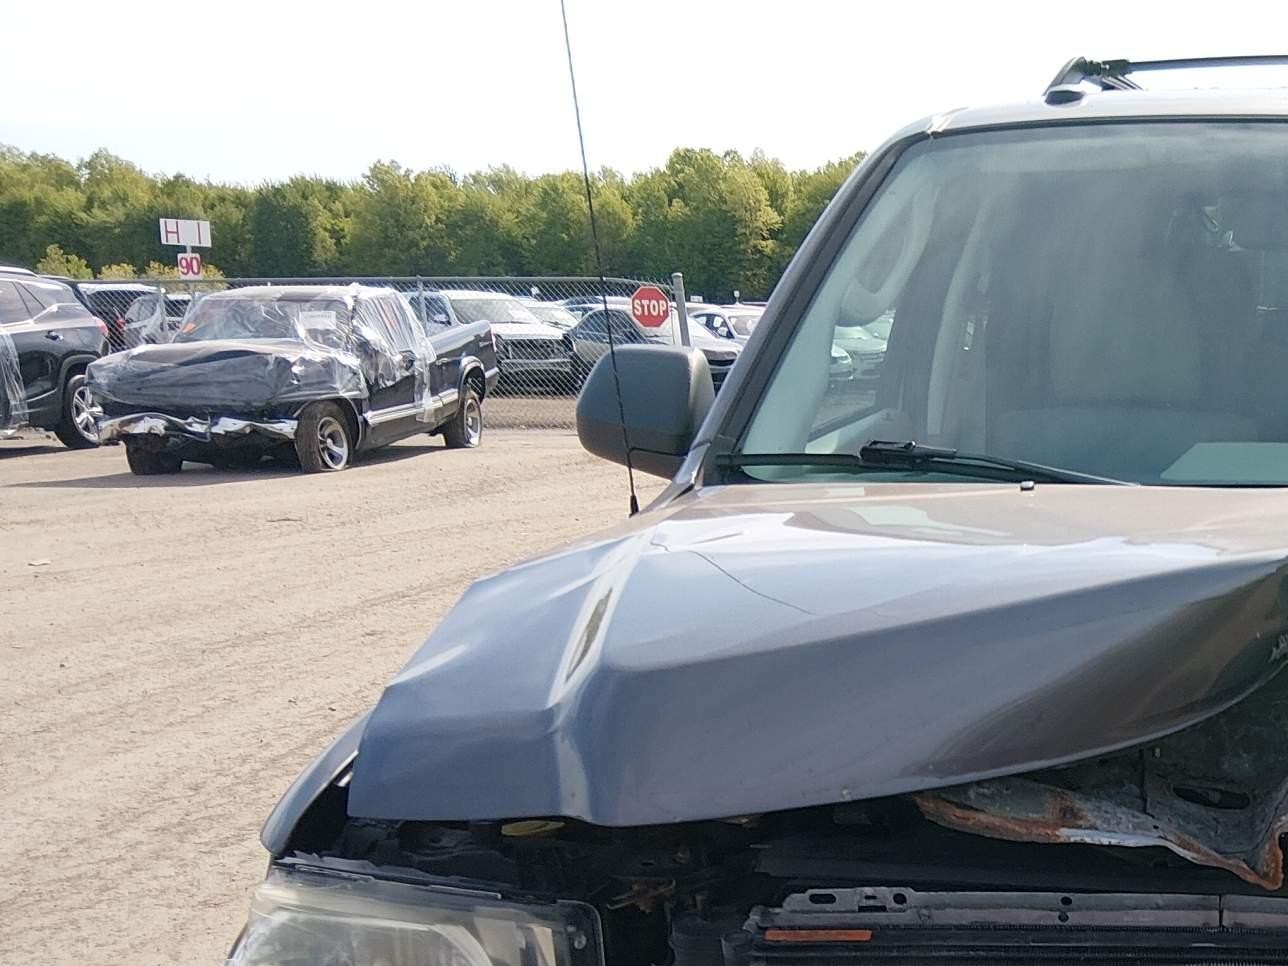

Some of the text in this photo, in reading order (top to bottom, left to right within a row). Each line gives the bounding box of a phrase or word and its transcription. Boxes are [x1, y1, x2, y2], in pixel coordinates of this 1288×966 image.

[164, 220, 180, 244] H
[179, 256, 201, 276] 90
[633, 299, 667, 316] STOP
